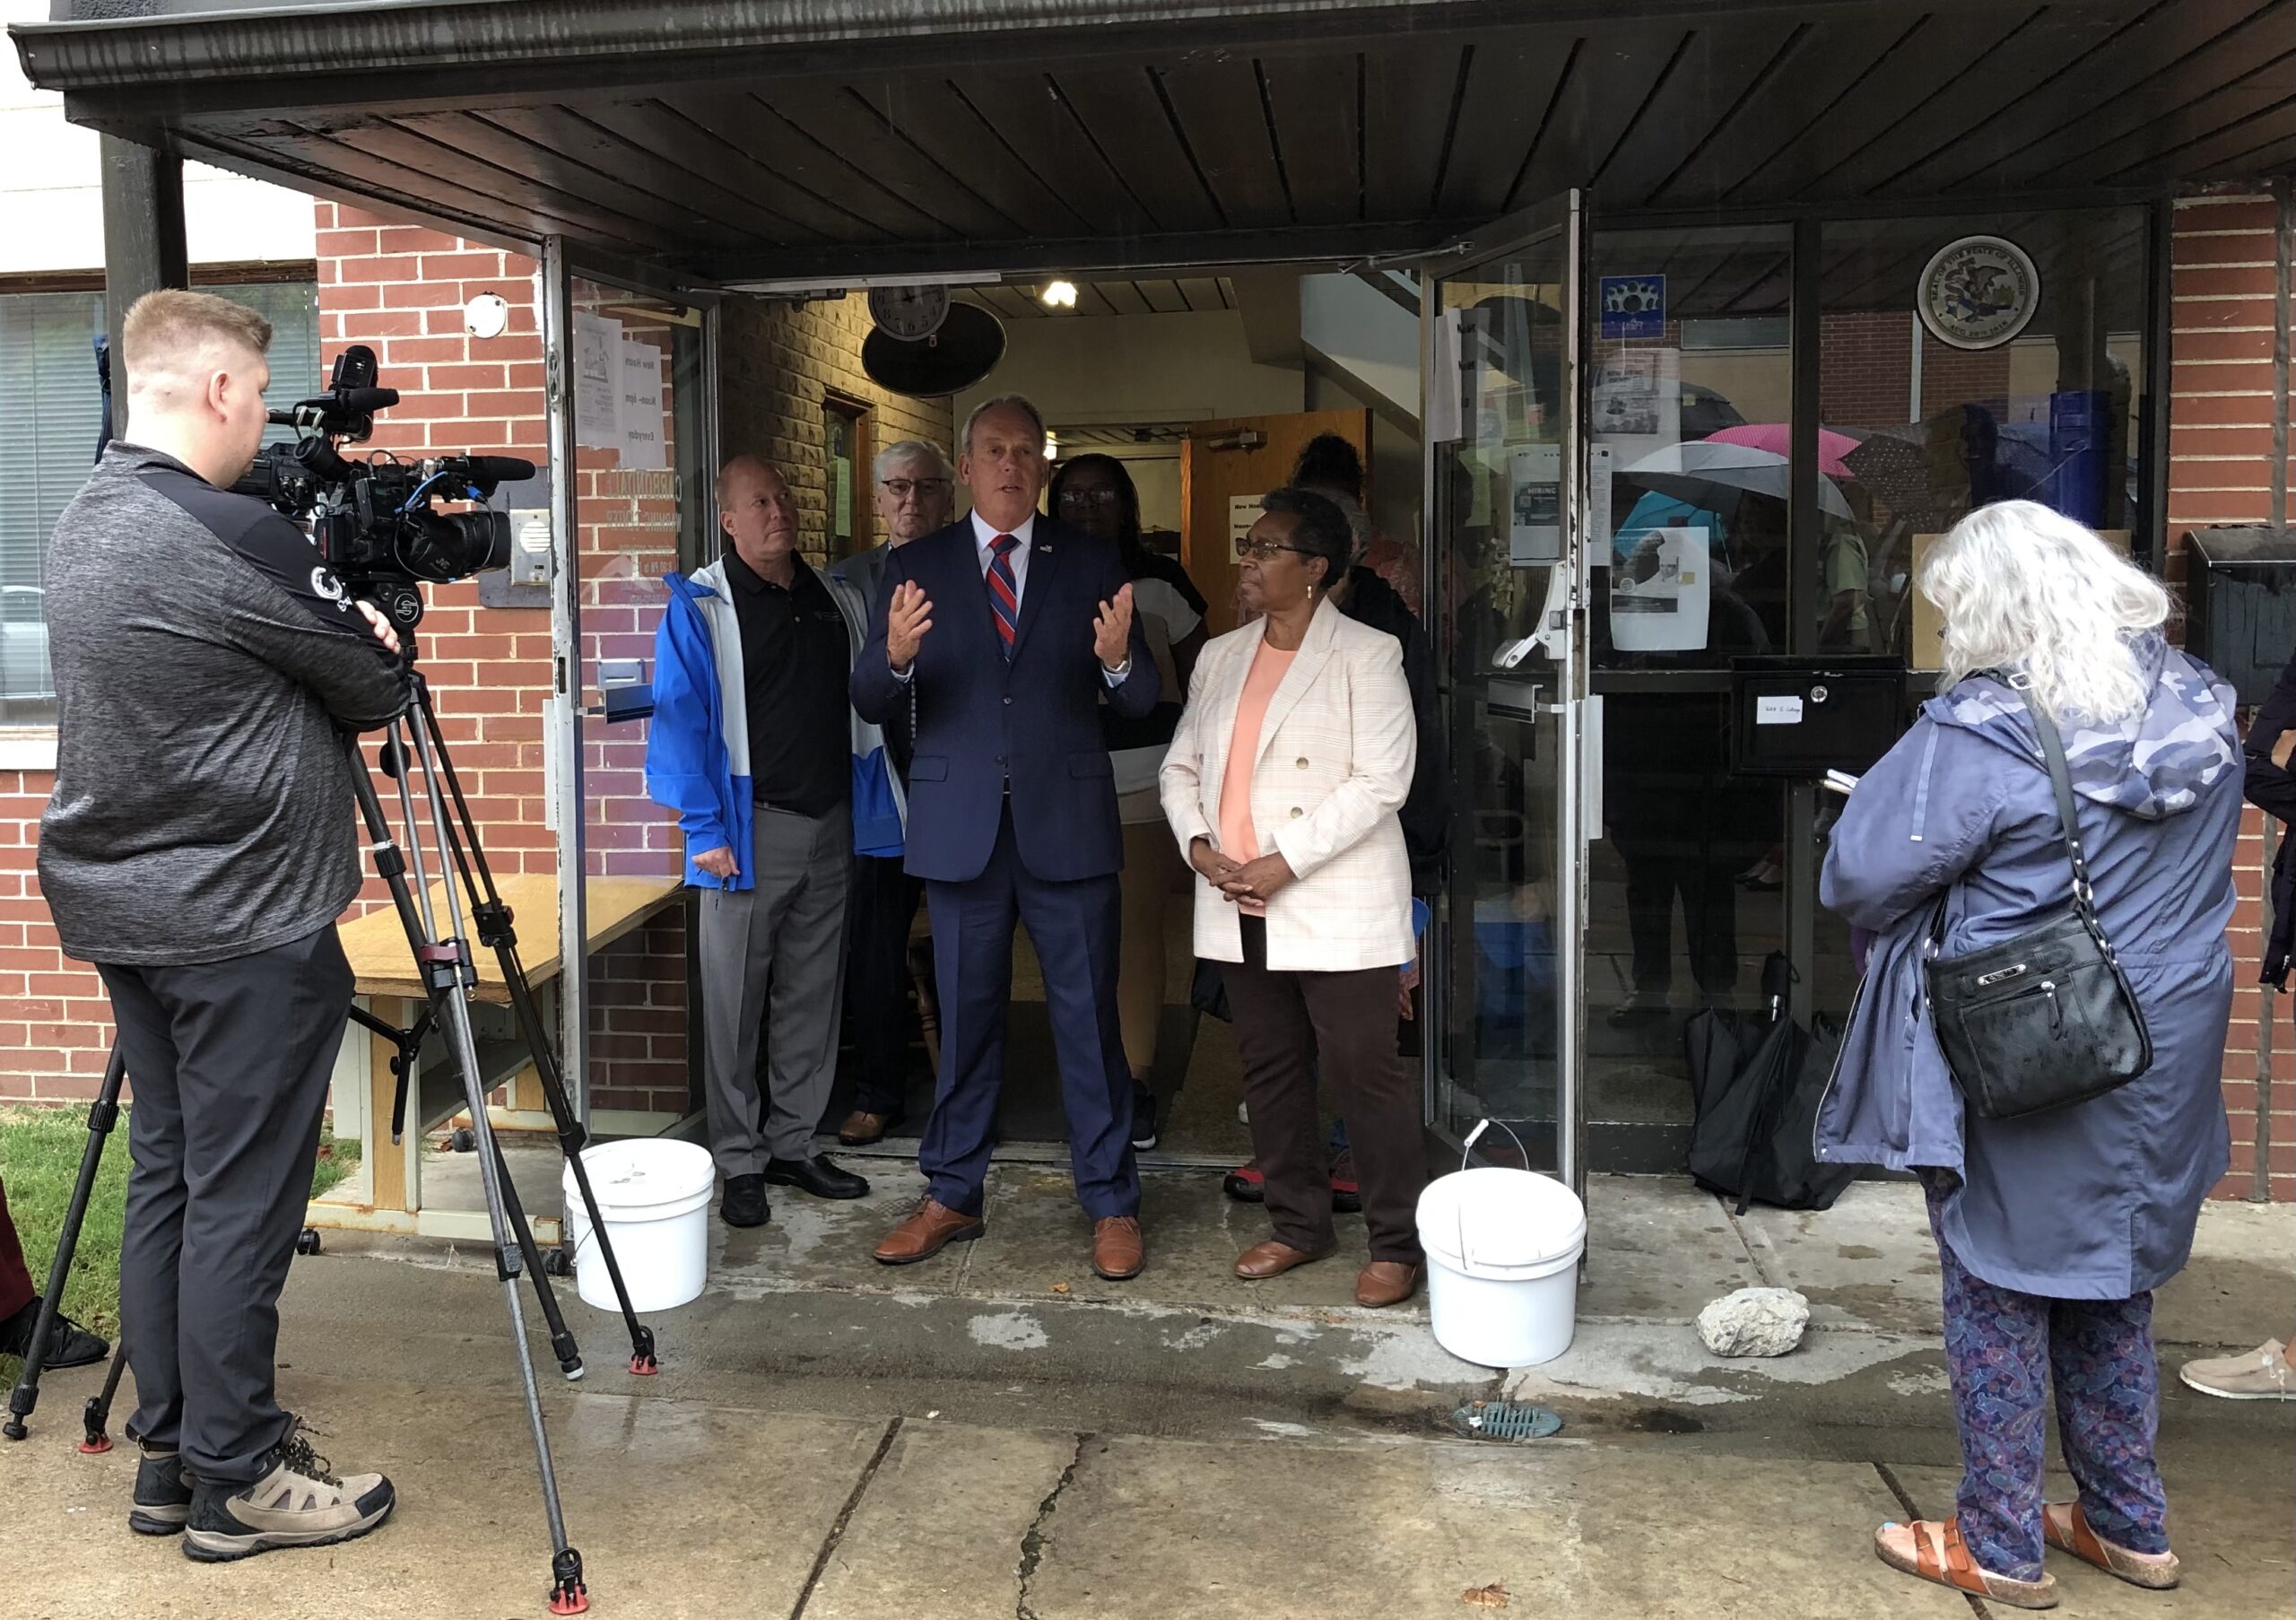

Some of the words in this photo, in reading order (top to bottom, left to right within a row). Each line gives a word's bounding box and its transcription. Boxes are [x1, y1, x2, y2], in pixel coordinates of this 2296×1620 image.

[1965, 248, 1995, 257] STATE
[1527, 487, 1557, 495] HIRING
[436, 557, 451, 570] JVC
